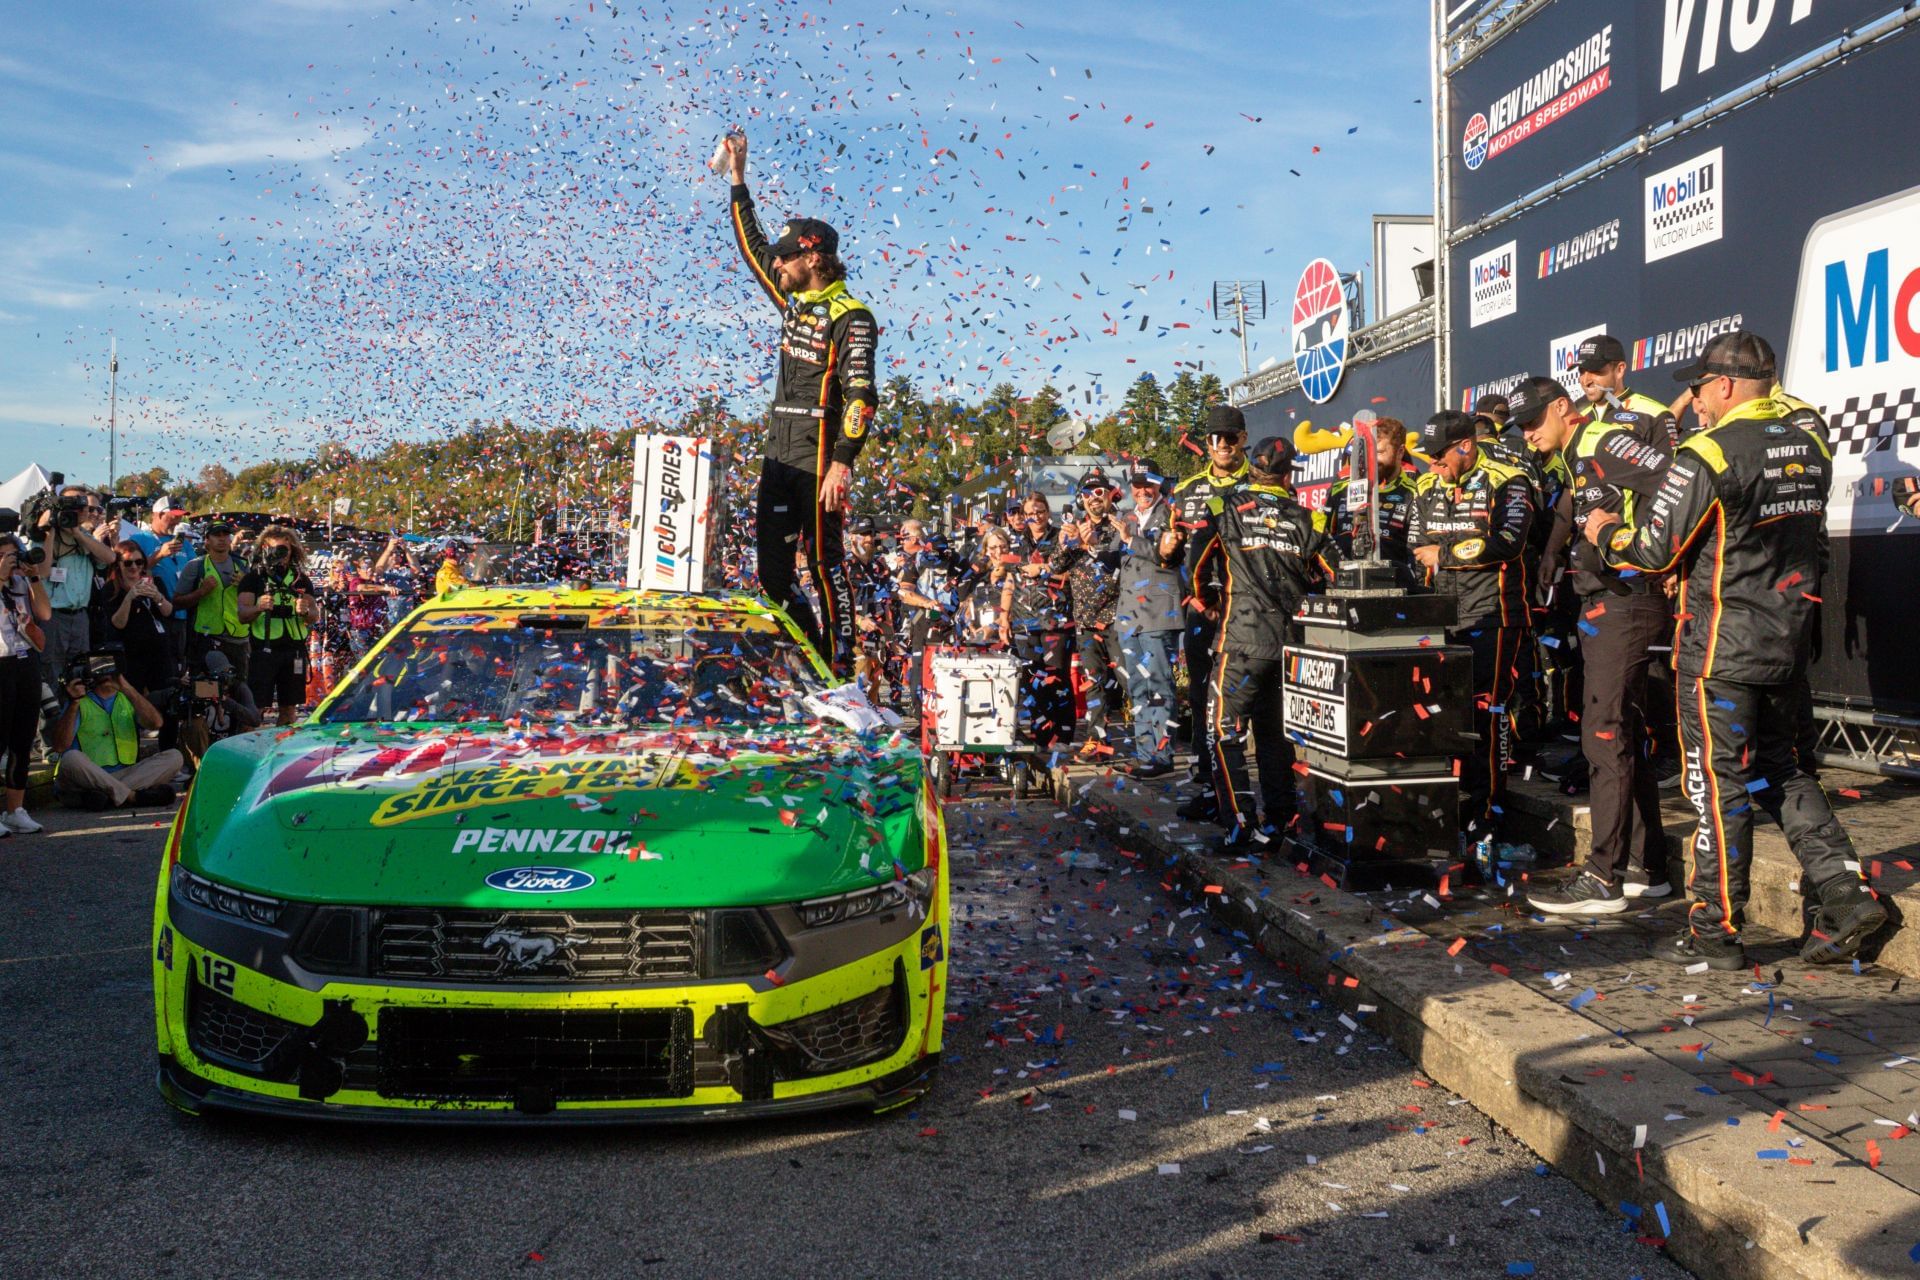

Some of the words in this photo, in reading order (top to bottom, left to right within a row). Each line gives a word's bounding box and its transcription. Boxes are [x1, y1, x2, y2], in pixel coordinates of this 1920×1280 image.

[1489, 86, 1521, 137] NEW
[1521, 24, 1612, 117] HAMPSHIRE
[1489, 120, 1531, 156] MOTOR
[1535, 70, 1607, 128] SPEEDWAY
[1653, 171, 1695, 212] Mobil
[1555, 218, 1620, 273] PLAYOFFS
[1653, 227, 1689, 249] VICTORY
[1691, 216, 1714, 236] LANE
[1475, 257, 1501, 287] Mobil
[788, 346, 818, 361] ARDS
[1556, 344, 1580, 372] Mob
[850, 405, 862, 436] PENNZOIL
[1298, 447, 1345, 483] HAMP
[1766, 444, 1808, 459] WHITT
[660, 440, 682, 513] SERIES
[1760, 499, 1823, 516] MENARS
[657, 513, 678, 556] CUP
[1241, 537, 1301, 555] MENARDS
[832, 571, 852, 637] DURACE
[1300, 656, 1336, 691] NASCAR
[1290, 695, 1305, 724] CUP
[1305, 699, 1336, 732] SERIES
[1206, 699, 1218, 771] DACELL
[1499, 703, 1510, 771] DURACE
[424, 759, 628, 790] CLEANIN
[381, 775, 544, 821] SINCE
[451, 826, 634, 854] PENNZOIL
[501, 867, 579, 892] Ford
[201, 955, 236, 996] 12
